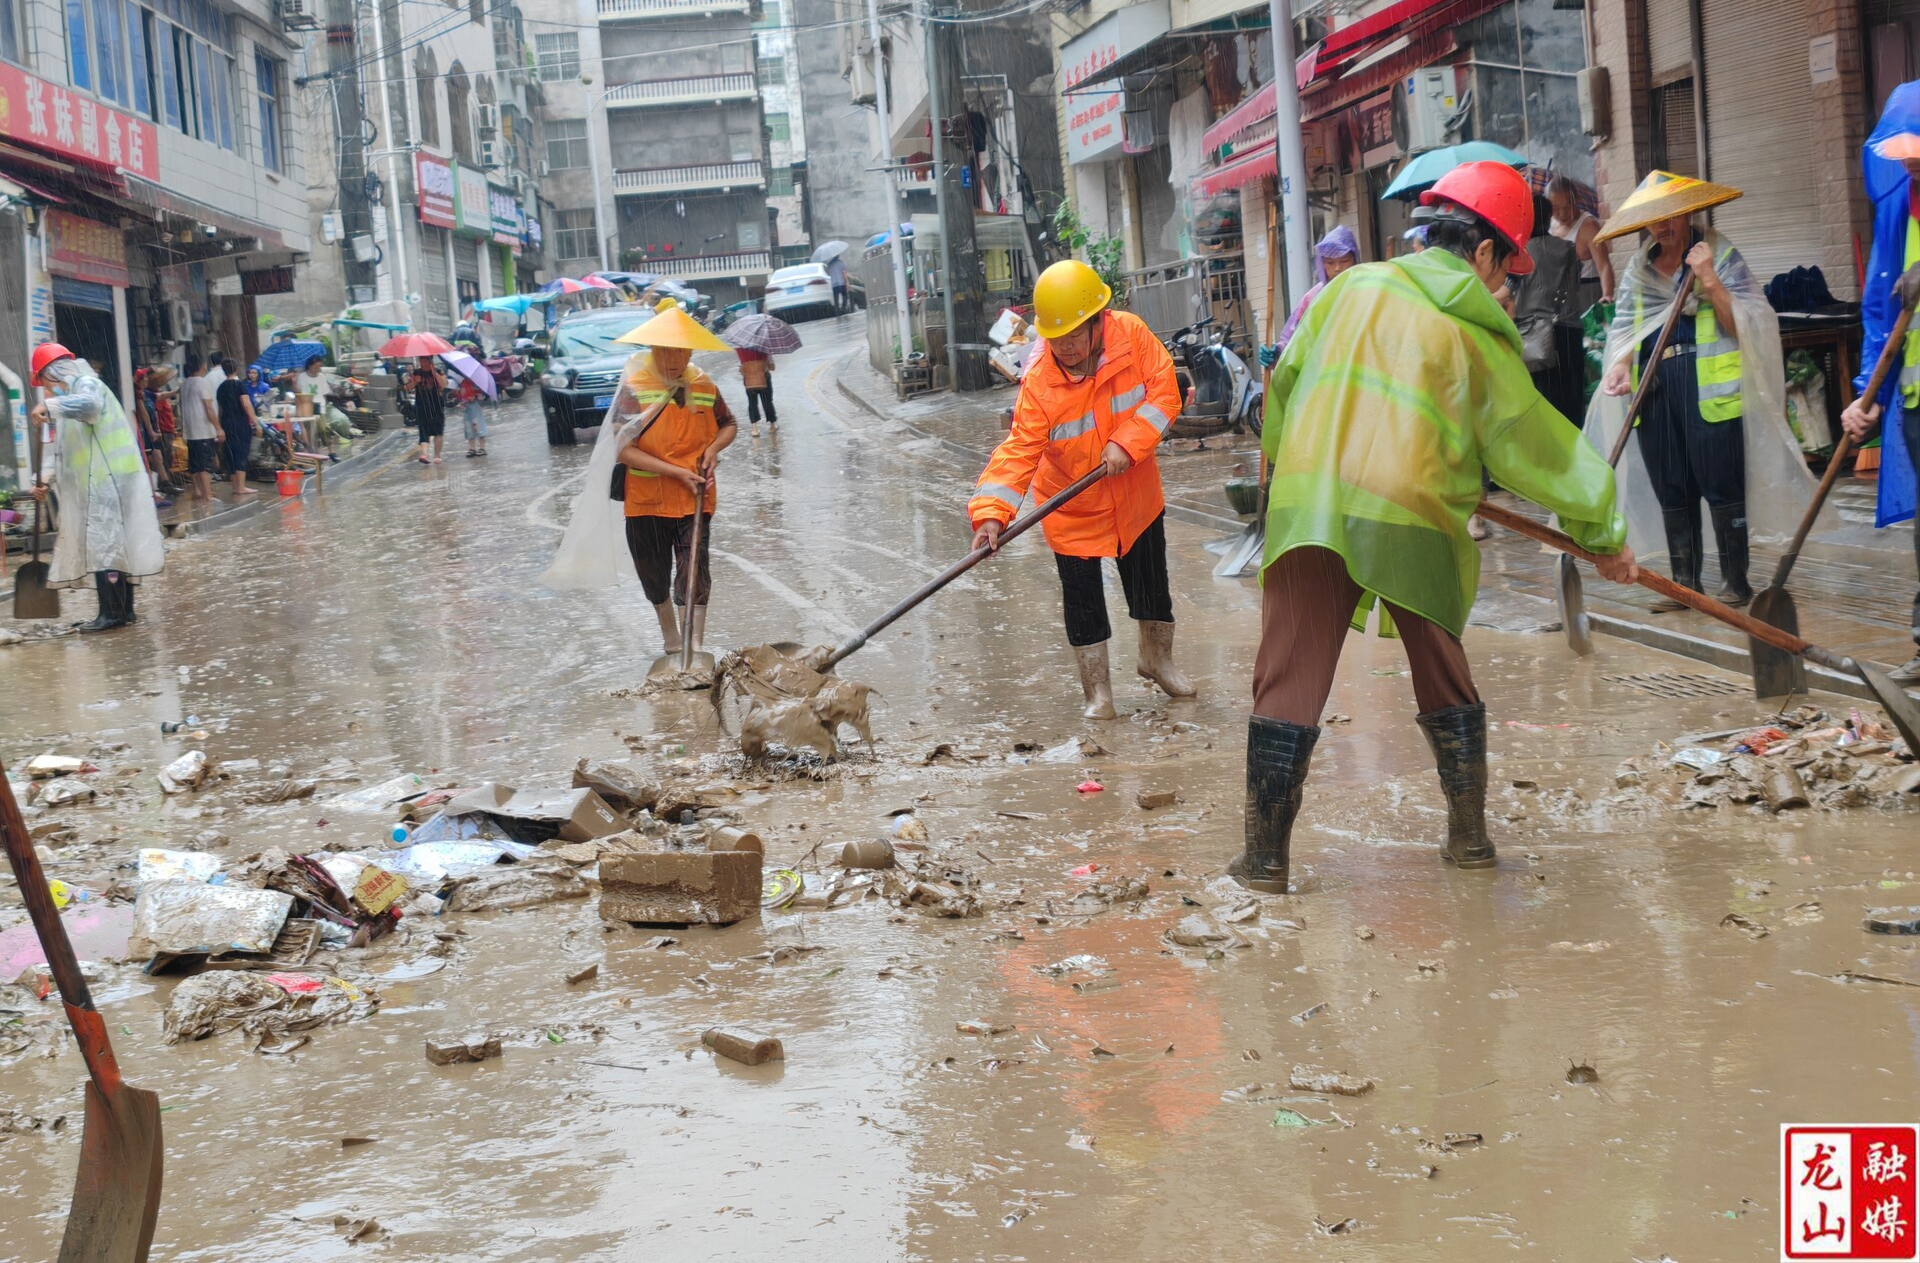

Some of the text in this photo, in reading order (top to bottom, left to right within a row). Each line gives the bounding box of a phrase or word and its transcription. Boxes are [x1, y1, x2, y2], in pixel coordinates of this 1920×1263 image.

[24, 75, 144, 172] 张妹副食店
